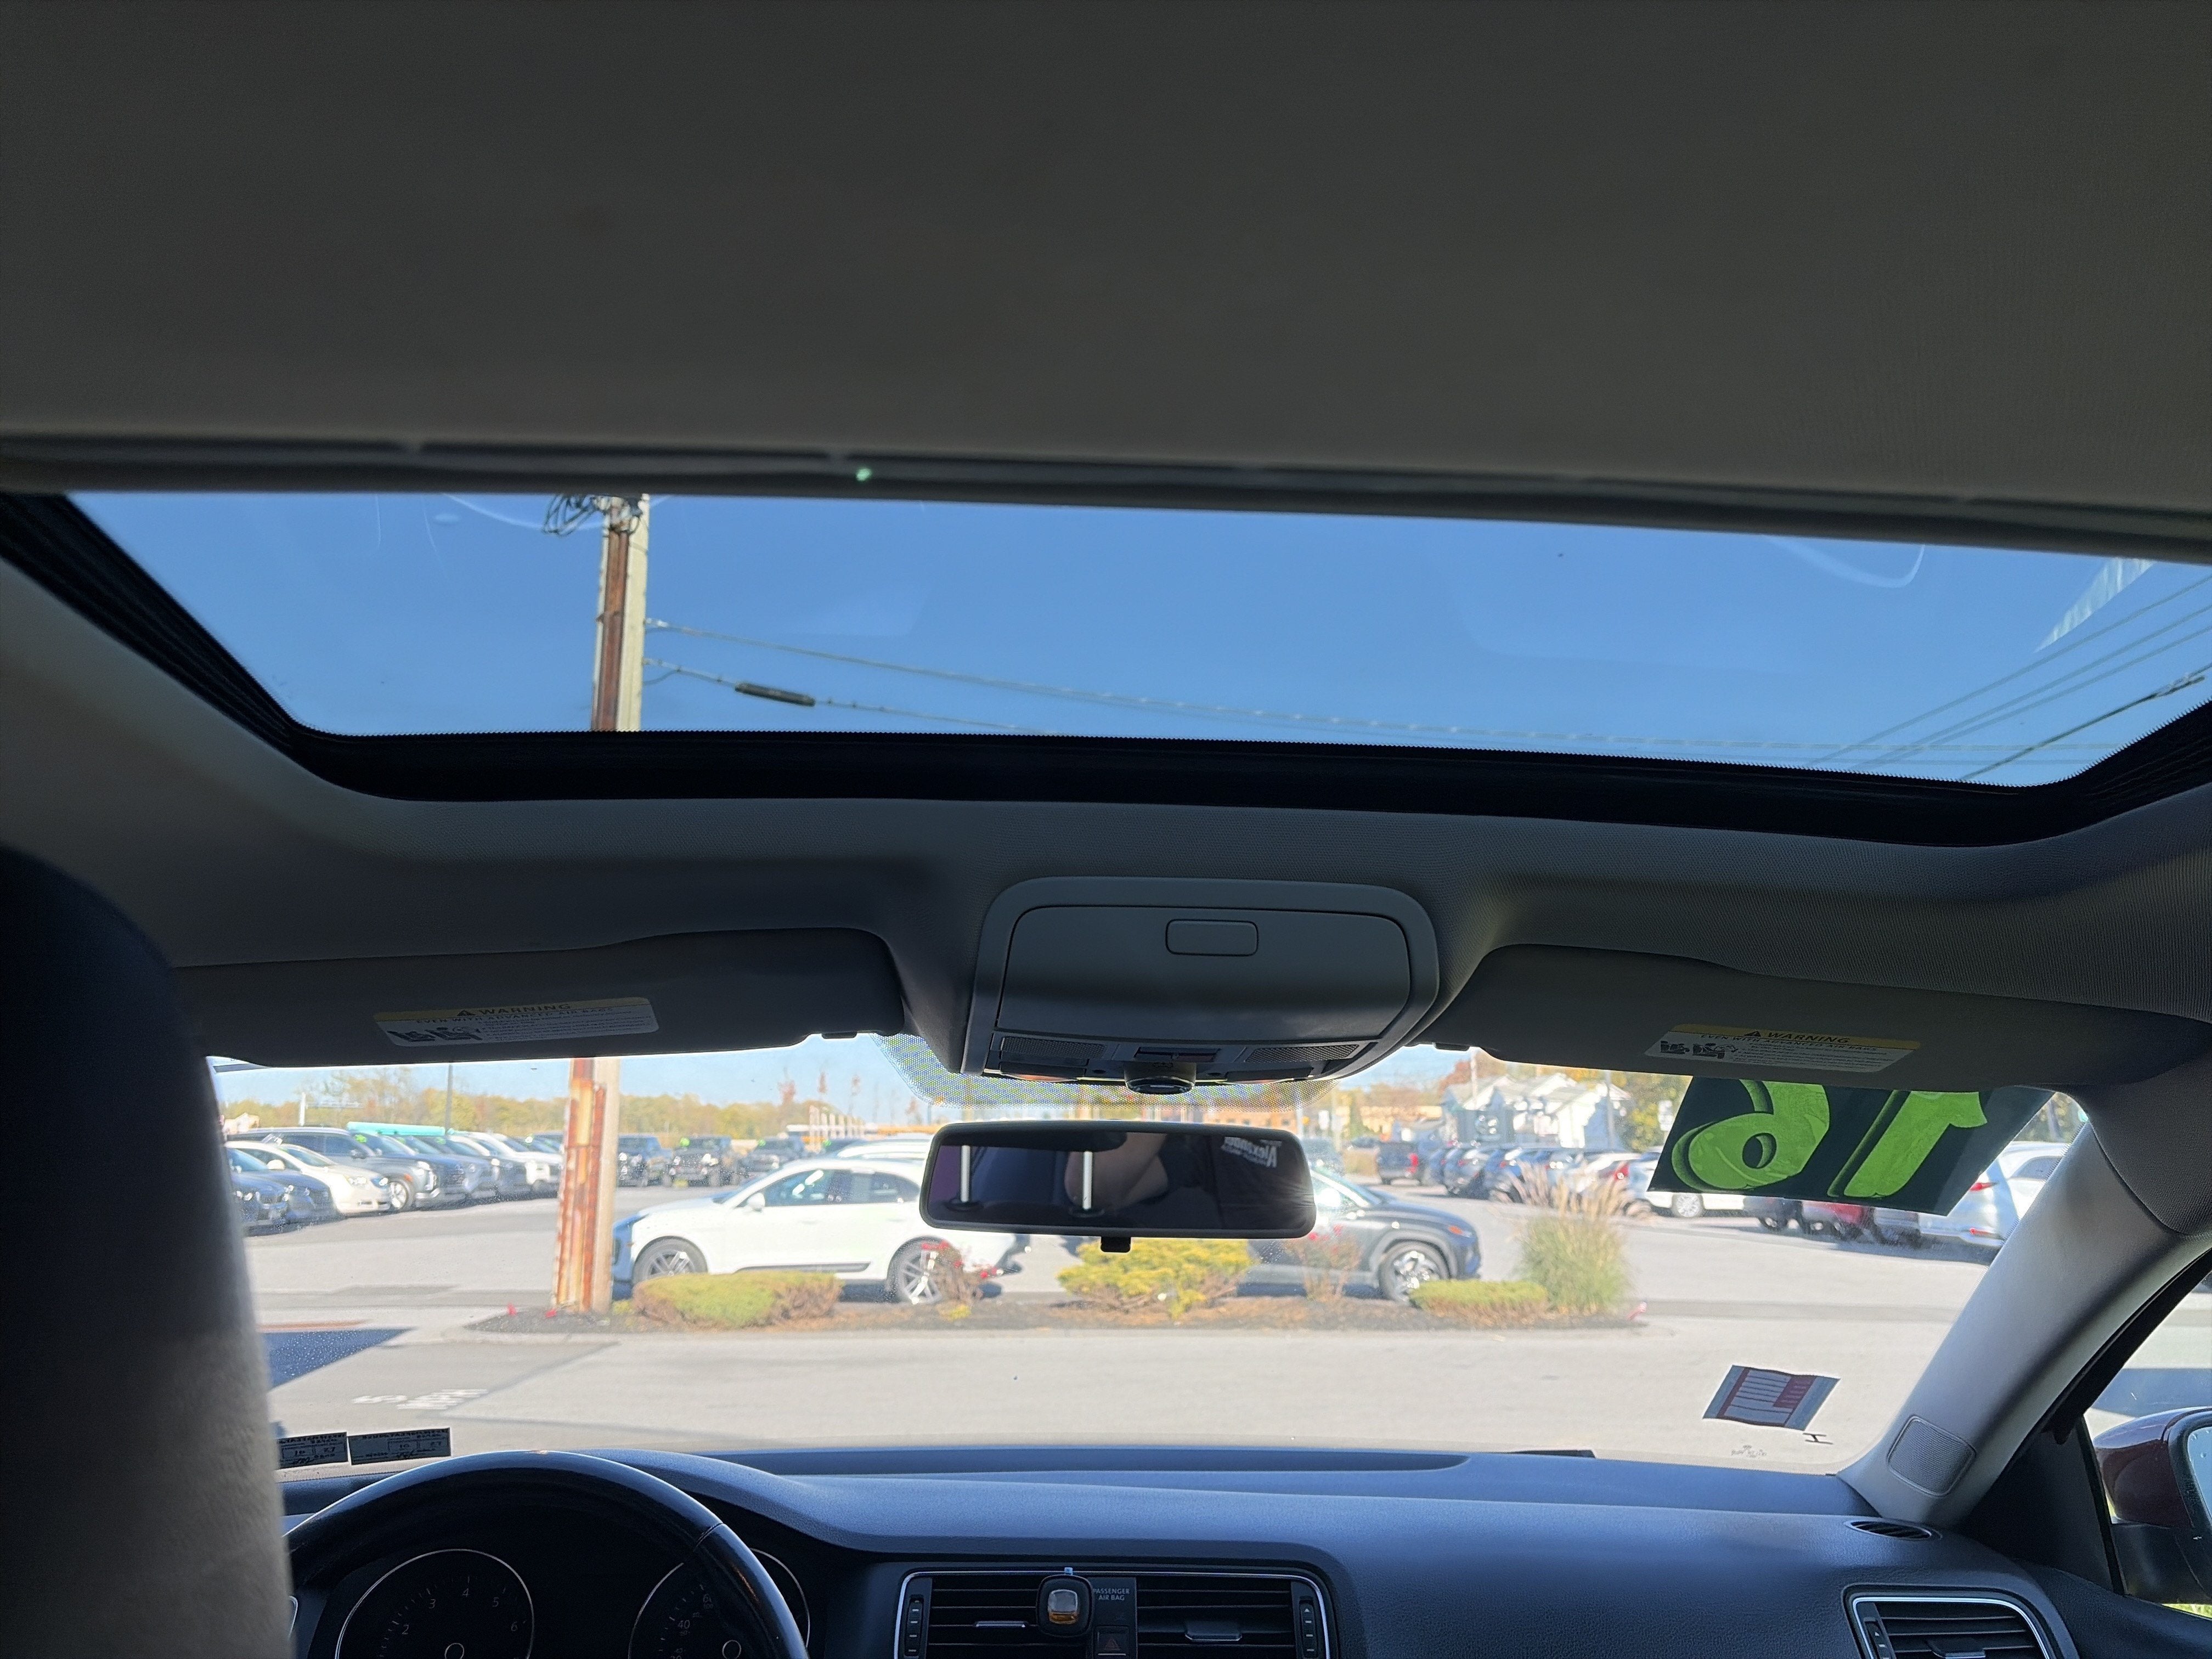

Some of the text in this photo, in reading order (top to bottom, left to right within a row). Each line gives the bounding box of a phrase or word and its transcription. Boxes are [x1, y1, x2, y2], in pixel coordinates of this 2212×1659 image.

[479, 1003, 571, 1015] WARNING
[488, 1012, 552, 1020] ADVANCED
[1768, 1032, 1852, 1043] WARNING
[462, 1588, 469, 1598] 4
[428, 1599, 436, 1609] 3
[492, 1597, 499, 1607] 5
[402, 1624, 409, 1635] 2
[511, 1621, 518, 1632] 6
[678, 1620, 691, 1629] 40
